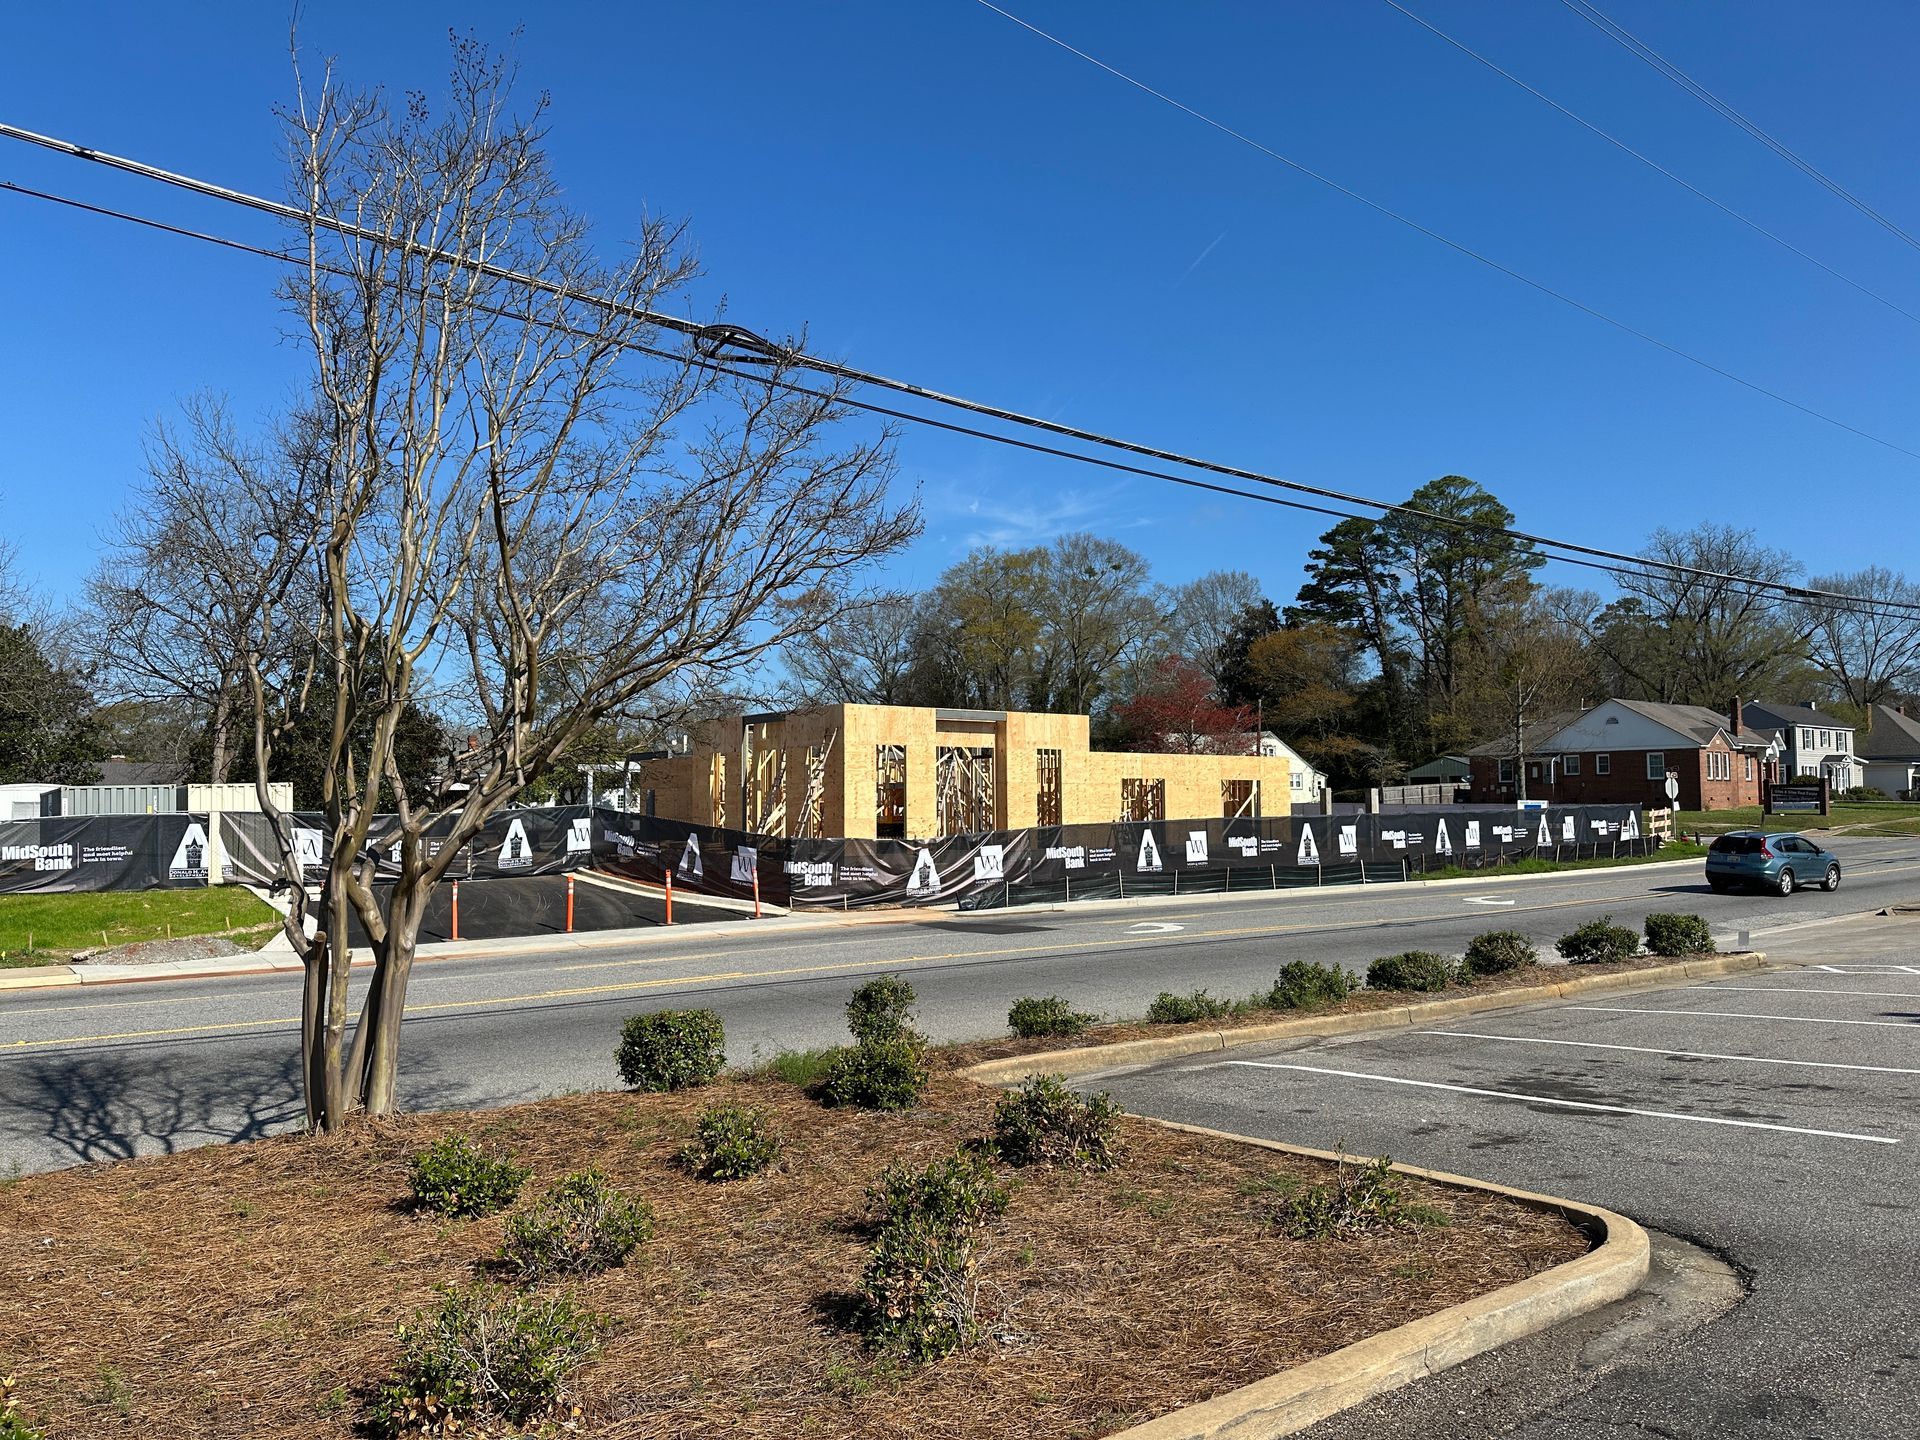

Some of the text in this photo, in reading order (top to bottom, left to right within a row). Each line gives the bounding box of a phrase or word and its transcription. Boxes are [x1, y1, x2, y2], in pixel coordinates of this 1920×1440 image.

[2, 843, 73, 860] MidSouth
[1046, 845, 1084, 859] MidSouth
[35, 857, 73, 871] Bank
[783, 861, 833, 874] MidSouth
[1065, 857, 1085, 869] Bank
[804, 873, 832, 886] Bank
